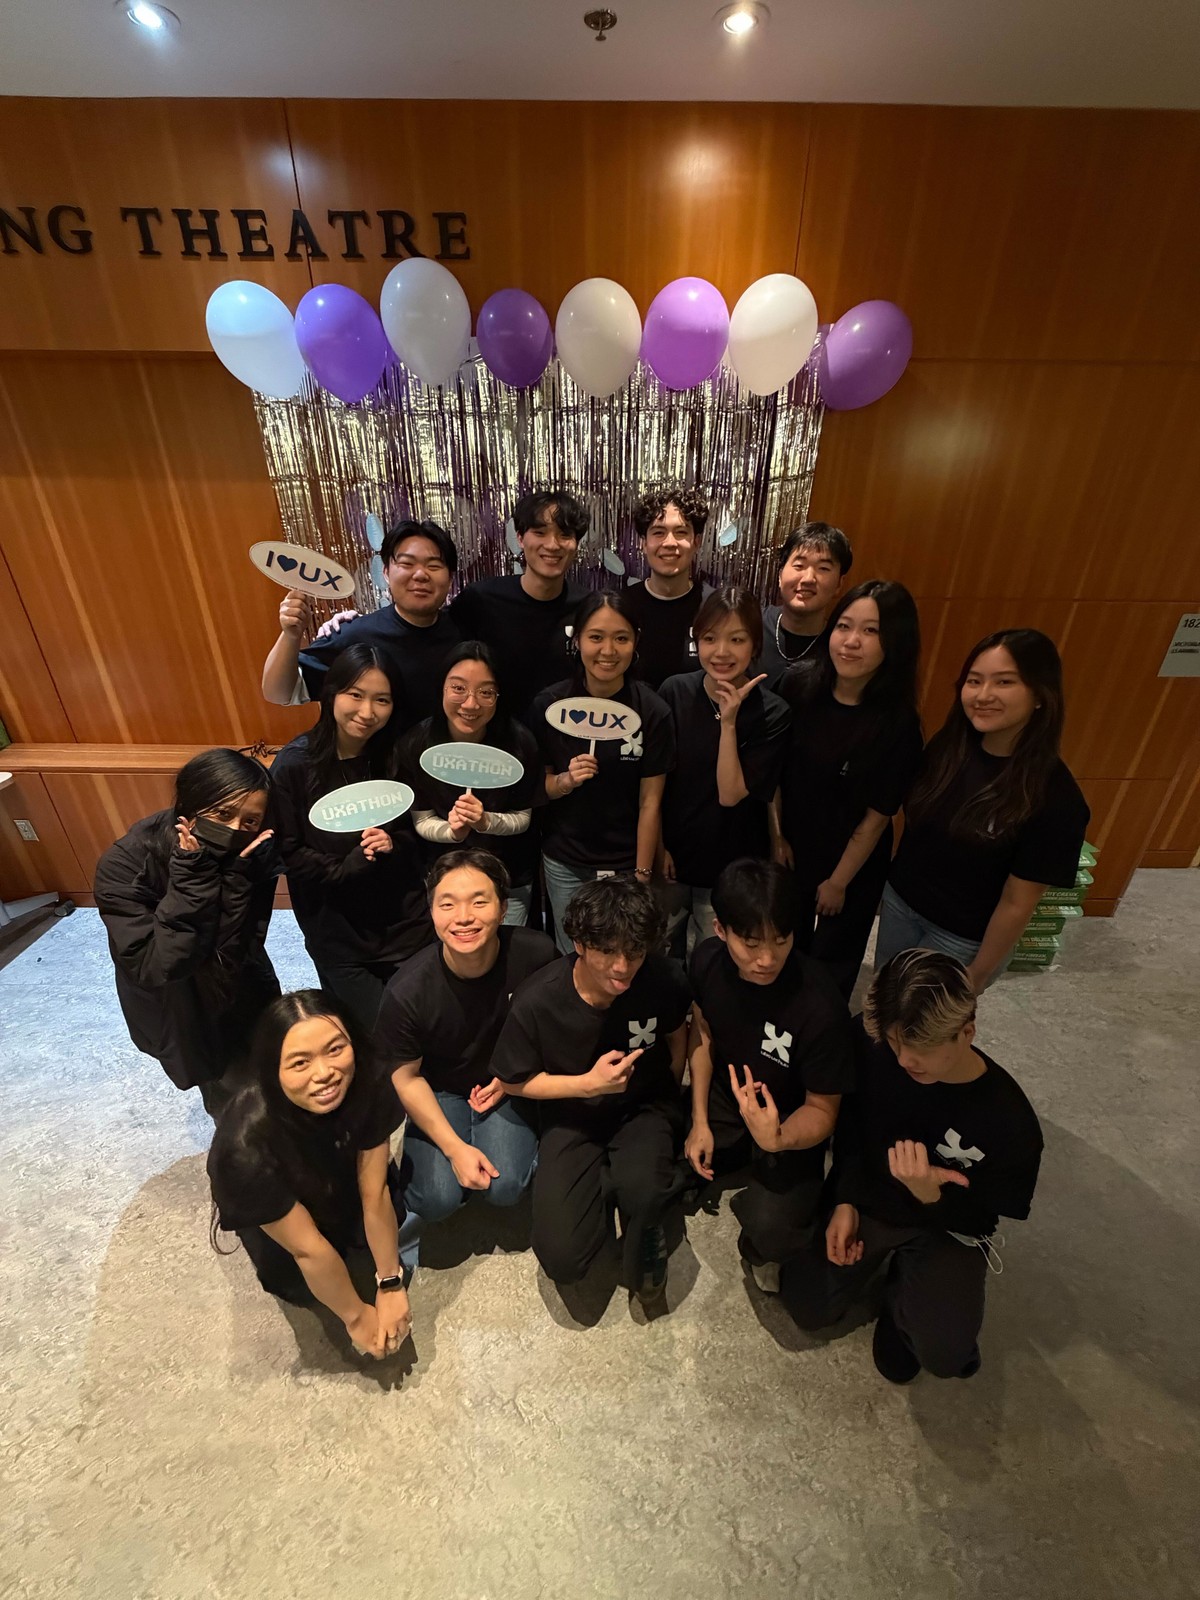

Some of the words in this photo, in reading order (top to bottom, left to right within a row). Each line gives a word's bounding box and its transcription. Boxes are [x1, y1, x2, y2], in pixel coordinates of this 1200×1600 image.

[120, 206, 471, 260] THEATRE
[265, 550, 275, 568] I
[298, 562, 343, 592] UX
[560, 708, 567, 724] I
[588, 711, 628, 730] UX
[432, 755, 513, 777] UXATHON
[321, 791, 403, 821] UXATHON
